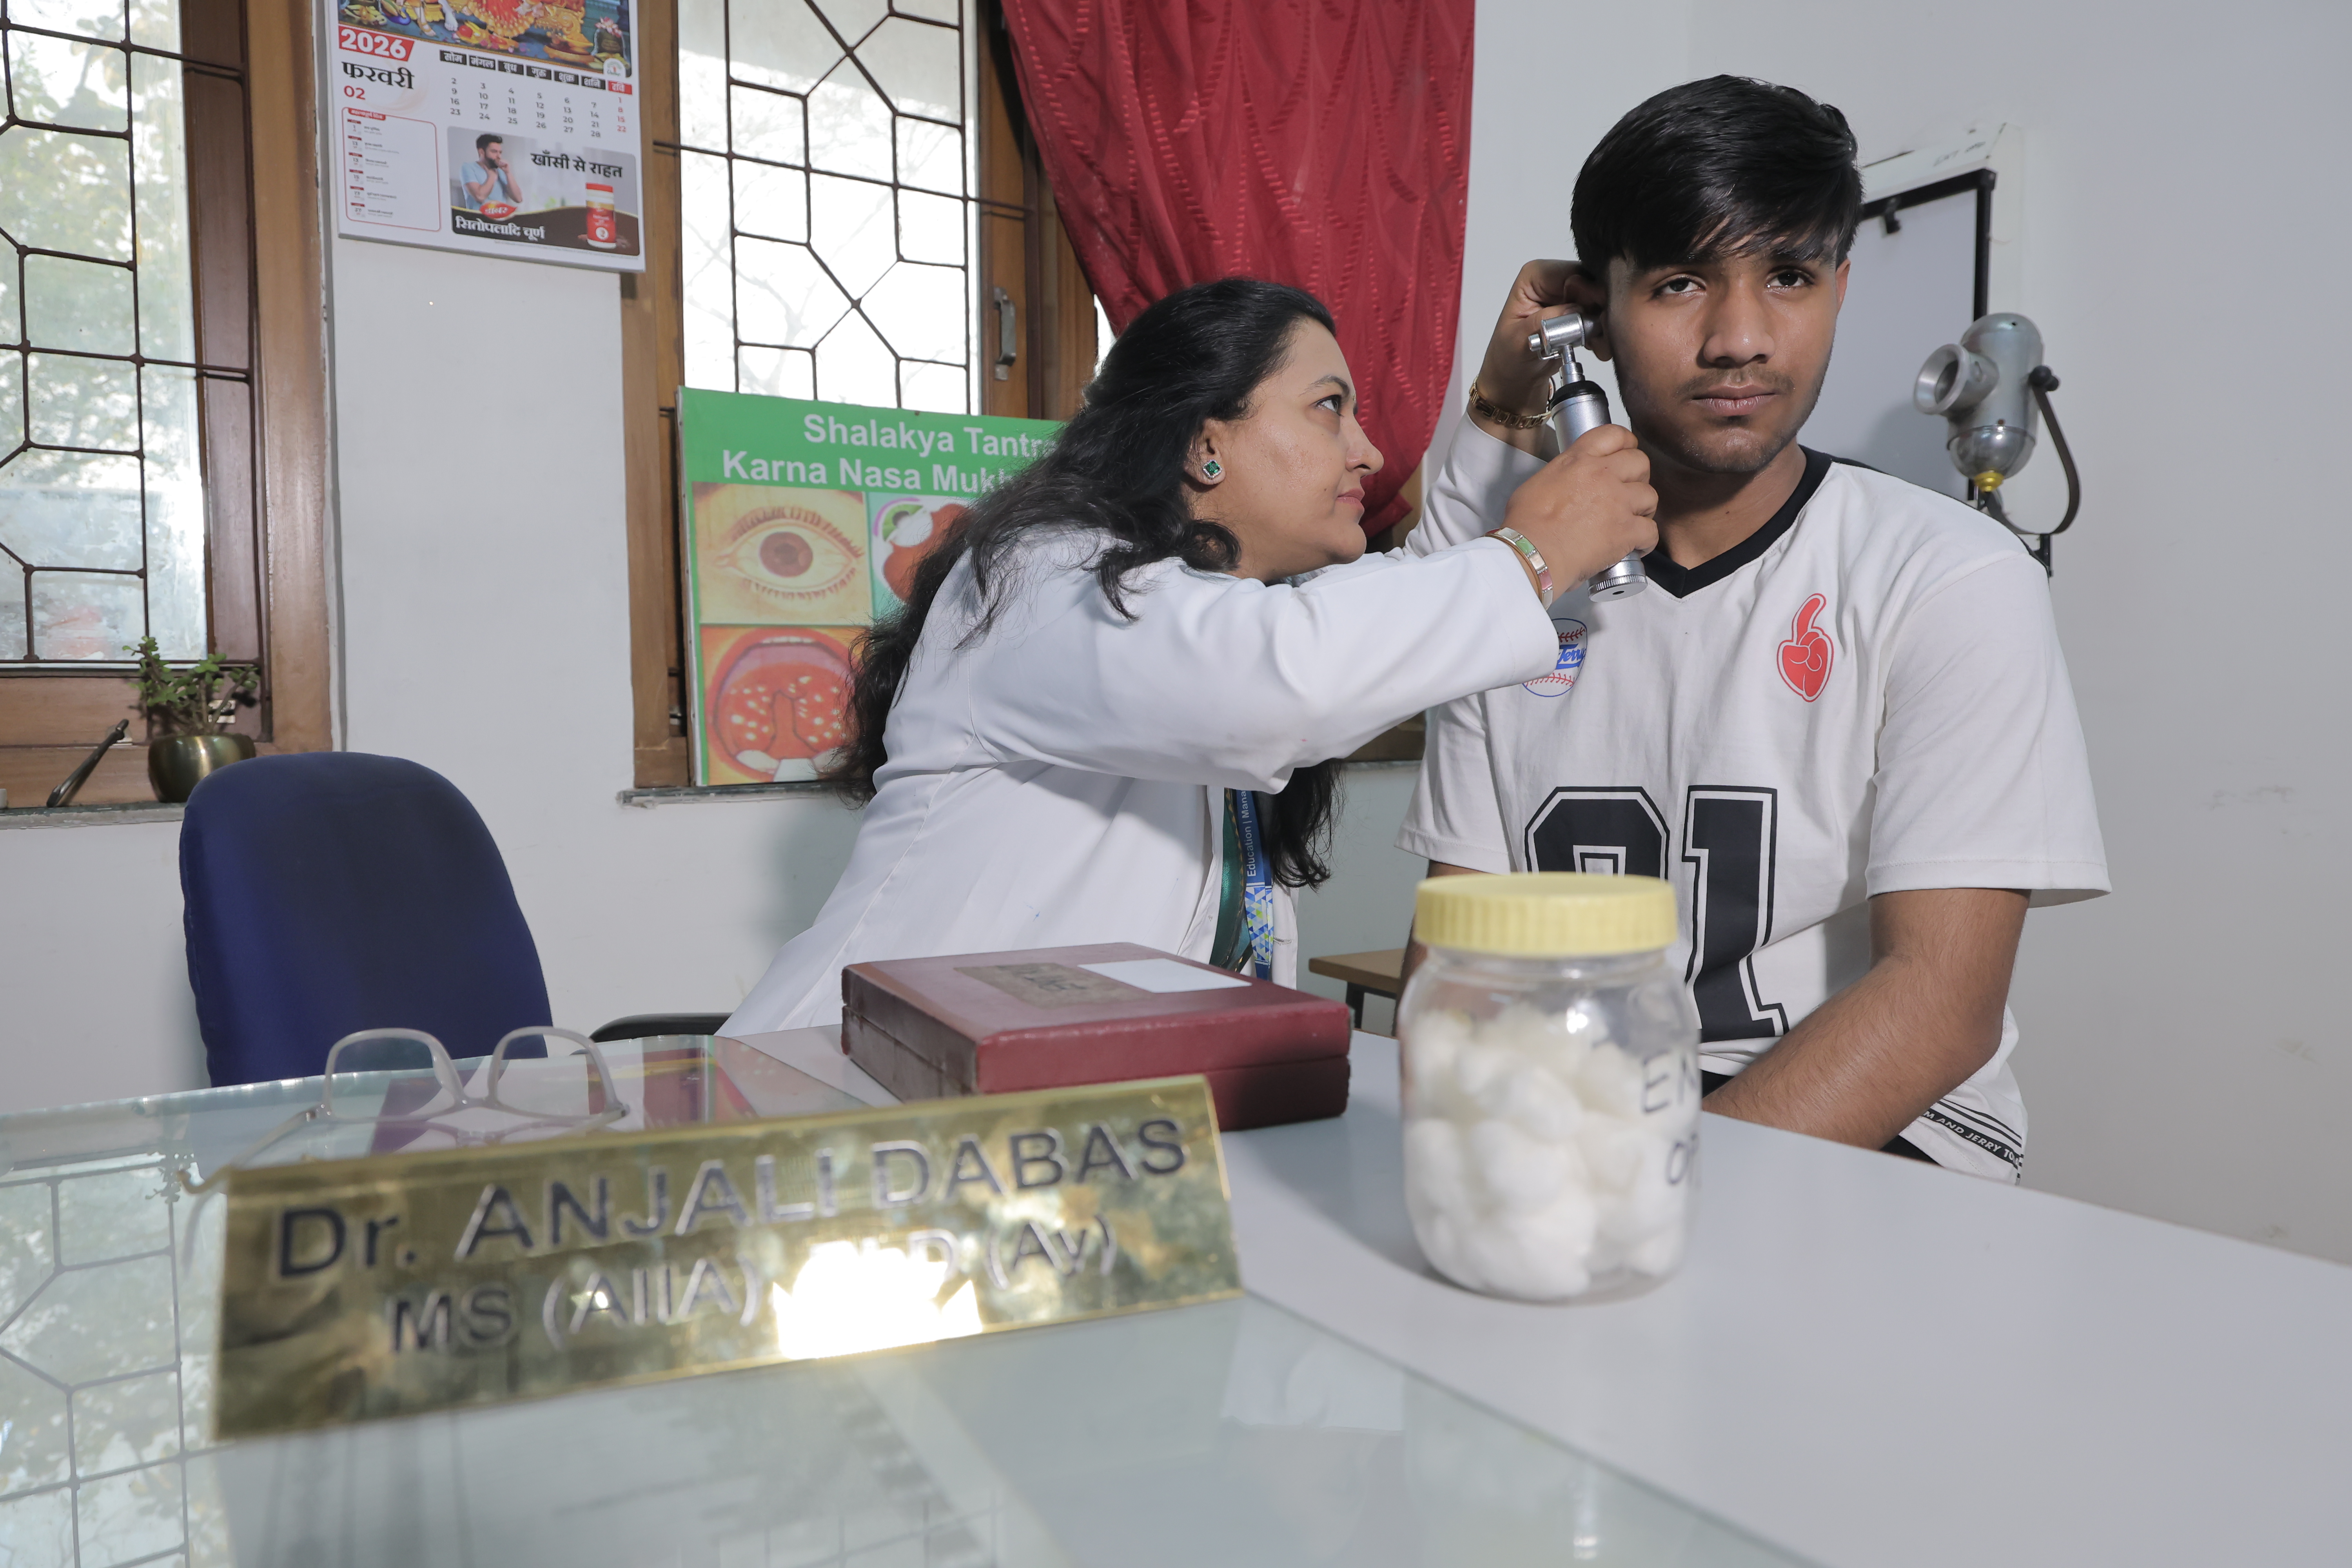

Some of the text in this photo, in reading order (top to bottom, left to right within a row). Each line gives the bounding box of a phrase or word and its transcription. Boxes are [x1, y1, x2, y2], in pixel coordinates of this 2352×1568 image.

[341, 28, 407, 59] 2026
[341, 61, 415, 89] फरवरी
[444, 52, 463, 63] सोम
[471, 56, 494, 69] मंगल
[503, 62, 517, 73] बुध
[584, 78, 601, 88] शनि
[344, 85, 365, 100] 02
[530, 149, 623, 178] खाँसी से राहत
[455, 215, 545, 241] सितोपलादि चूर्ण
[804, 414, 954, 457] Shalakya
[722, 449, 828, 485] Karna
[839, 458, 921, 490] Nasa
[1244, 826, 1256, 877] Education
[1937, 1118, 1964, 1133] AND
[1965, 1132, 2002, 1153] JERRY
[275, 1117, 1190, 1278] Dr. ANJALI DABAS
[386, 1282, 518, 1354] MS
